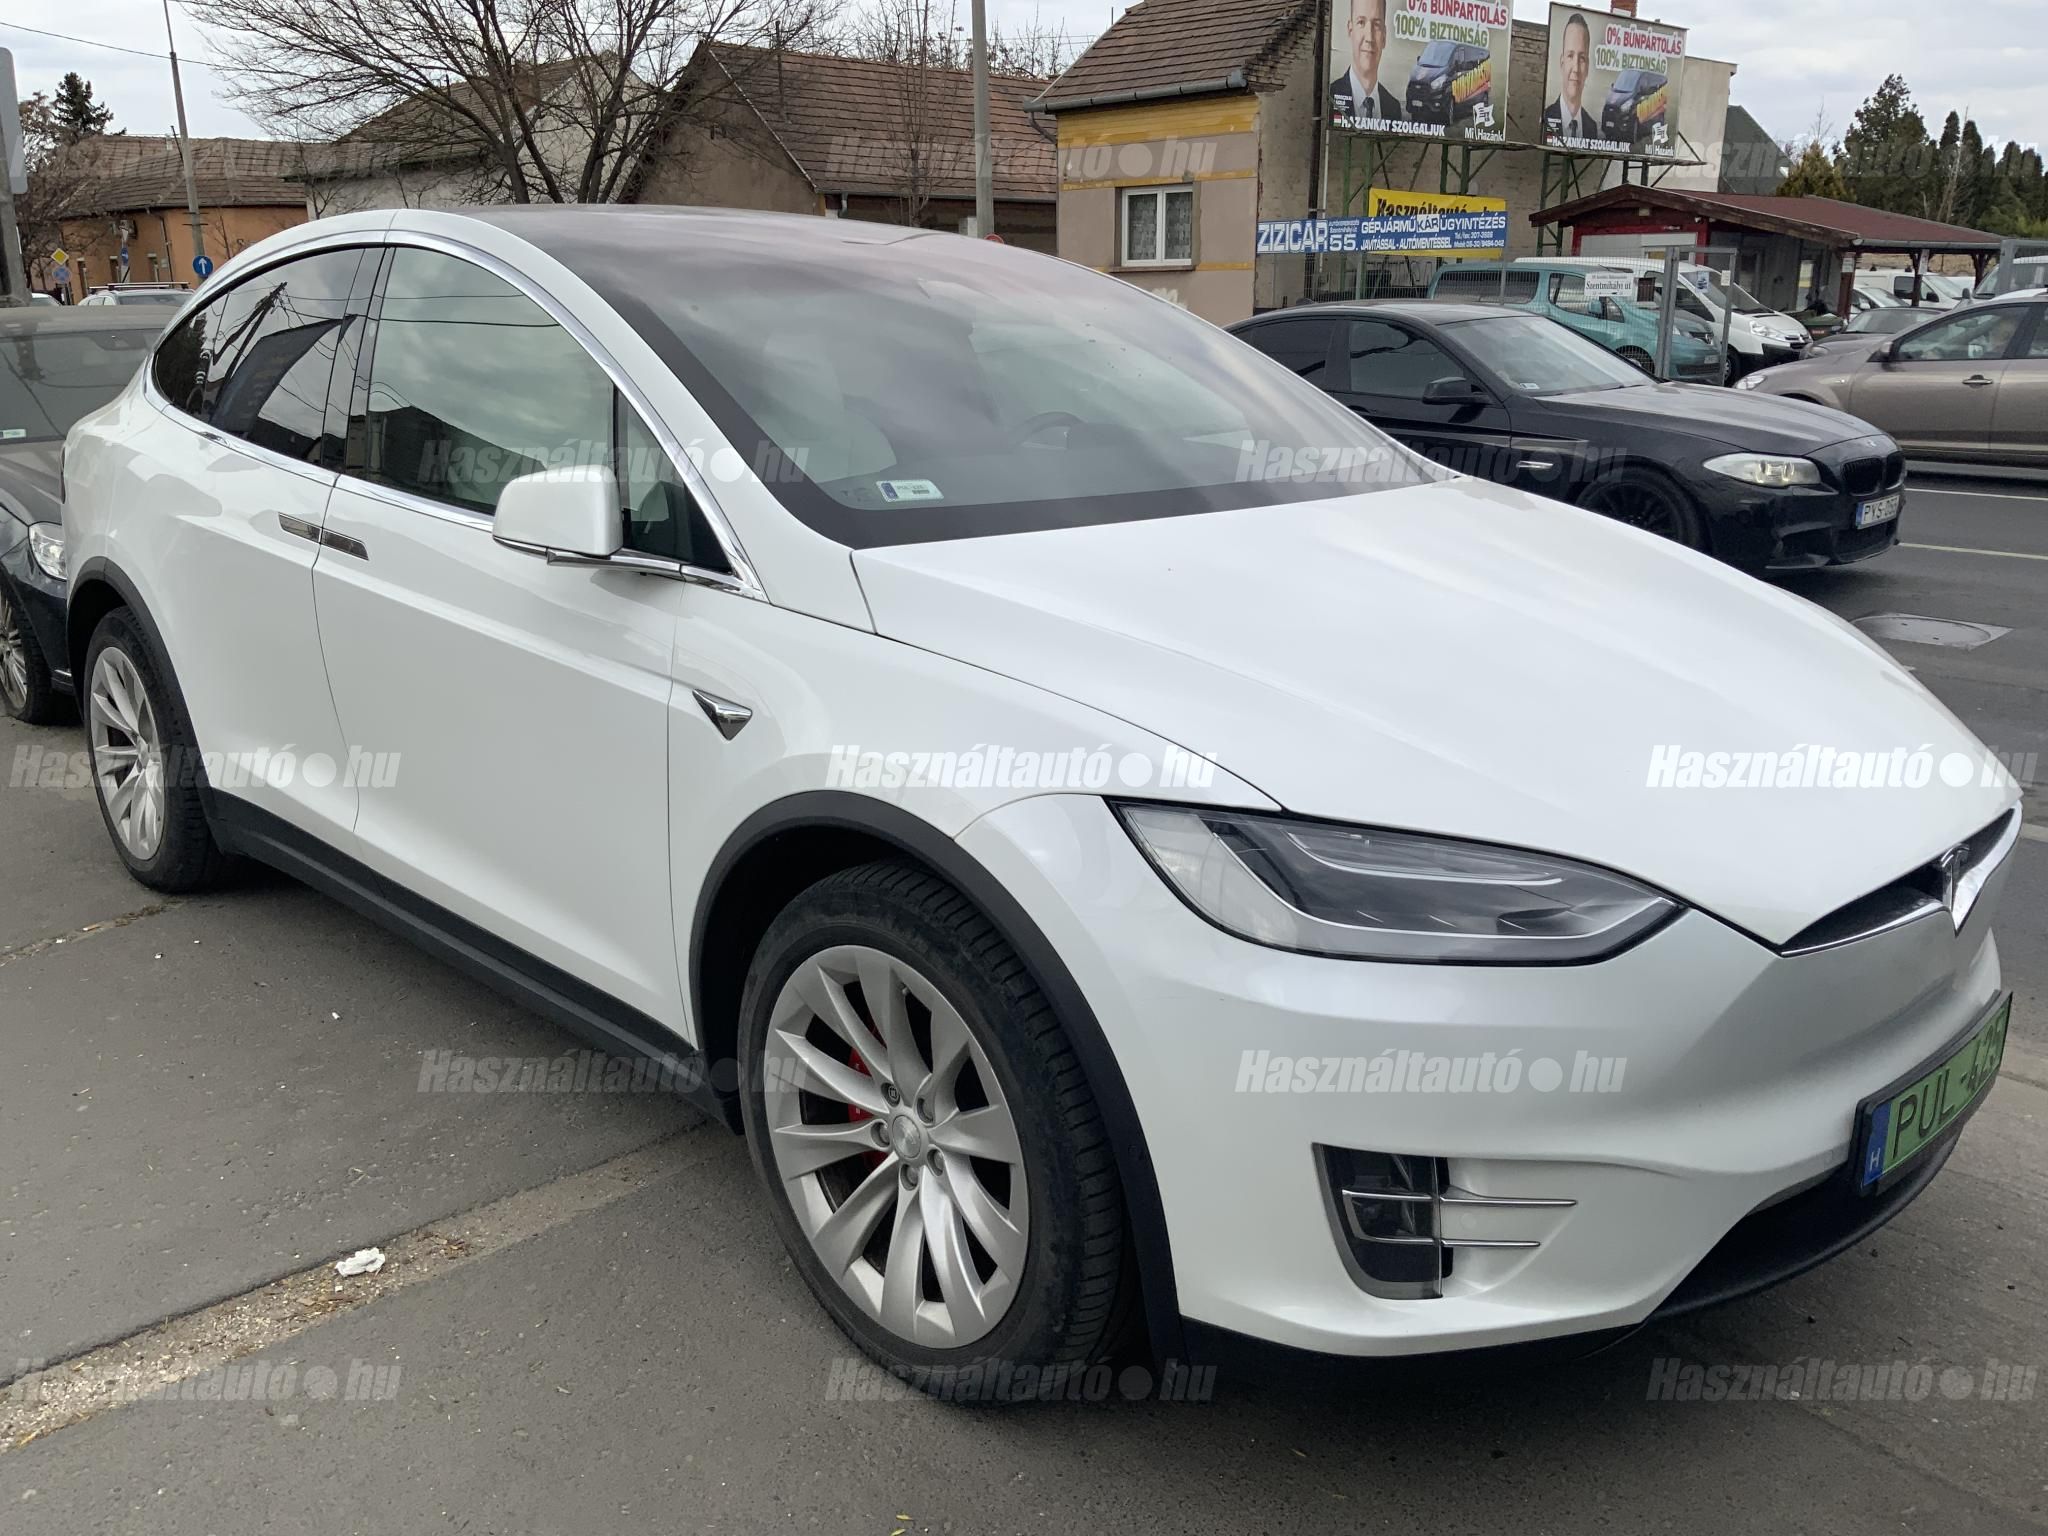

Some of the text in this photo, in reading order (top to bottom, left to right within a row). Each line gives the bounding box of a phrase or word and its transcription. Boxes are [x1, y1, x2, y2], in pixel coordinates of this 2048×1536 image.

[1396, 14, 1488, 47] 100% BIZTONSÁG
[1607, 25, 1682, 55] 0% BŰNPÁRTOLÁS
[1596, 47, 1666, 74] 100% BIZTONSÁG
[1464, 127, 1503, 141] Mi Hazánk
[1257, 220, 1328, 253] ZIZICAR
[1361, 216, 1416, 234] GÉPJÁRMŰ
[1329, 233, 1359, 251] 55.
[1869, 1147, 1880, 1171] H
